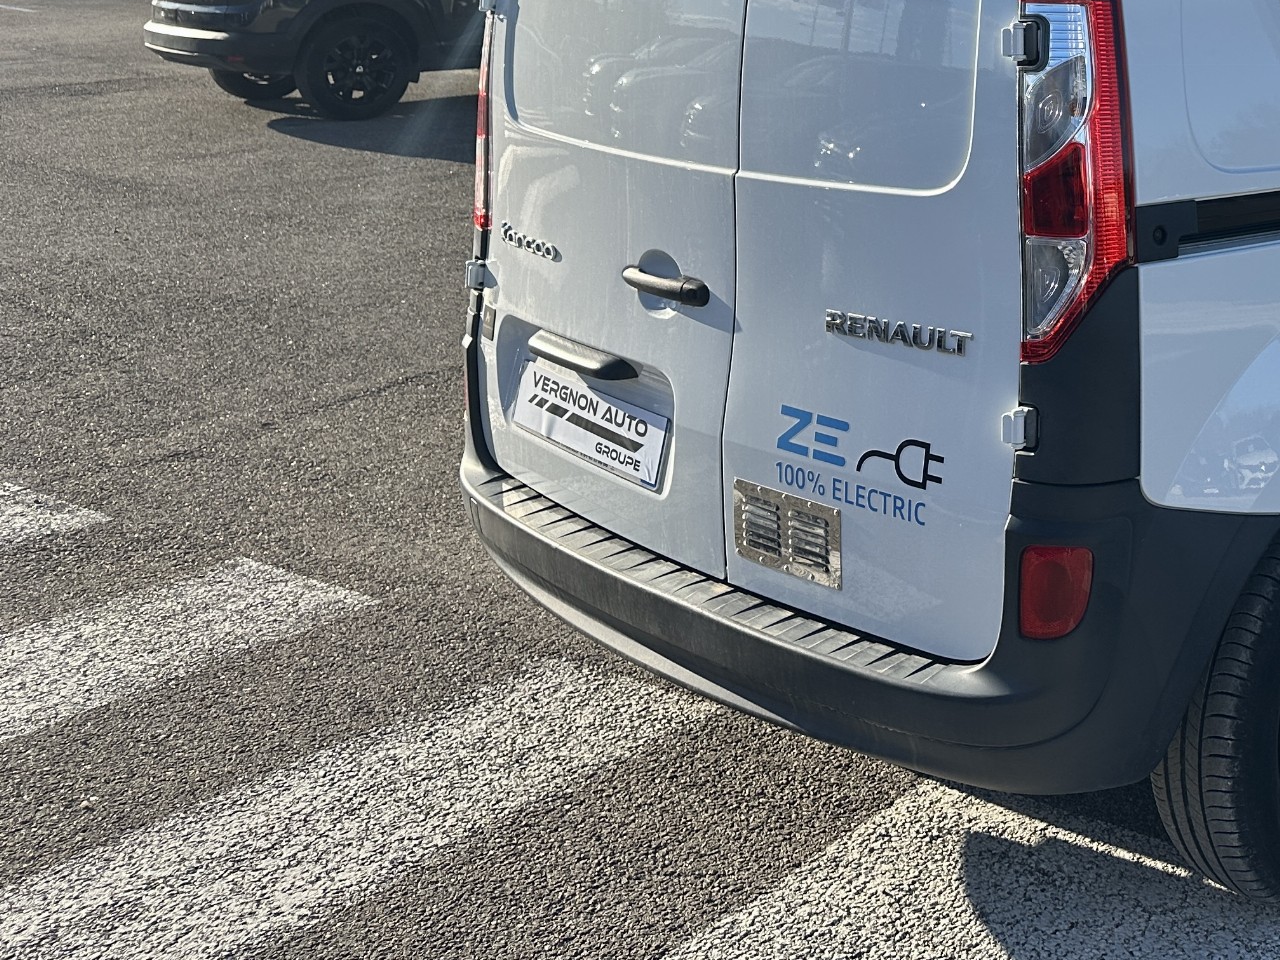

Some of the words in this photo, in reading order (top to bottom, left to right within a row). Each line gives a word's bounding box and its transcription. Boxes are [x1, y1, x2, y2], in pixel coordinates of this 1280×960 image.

[825, 308, 974, 357] RENAULT
[533, 370, 600, 417] VERGNON
[600, 405, 649, 438] AUTO
[776, 404, 850, 467] ZE
[595, 442, 642, 472] GROUPE
[775, 461, 826, 496] 100%
[832, 477, 926, 527] ELECTRIC
